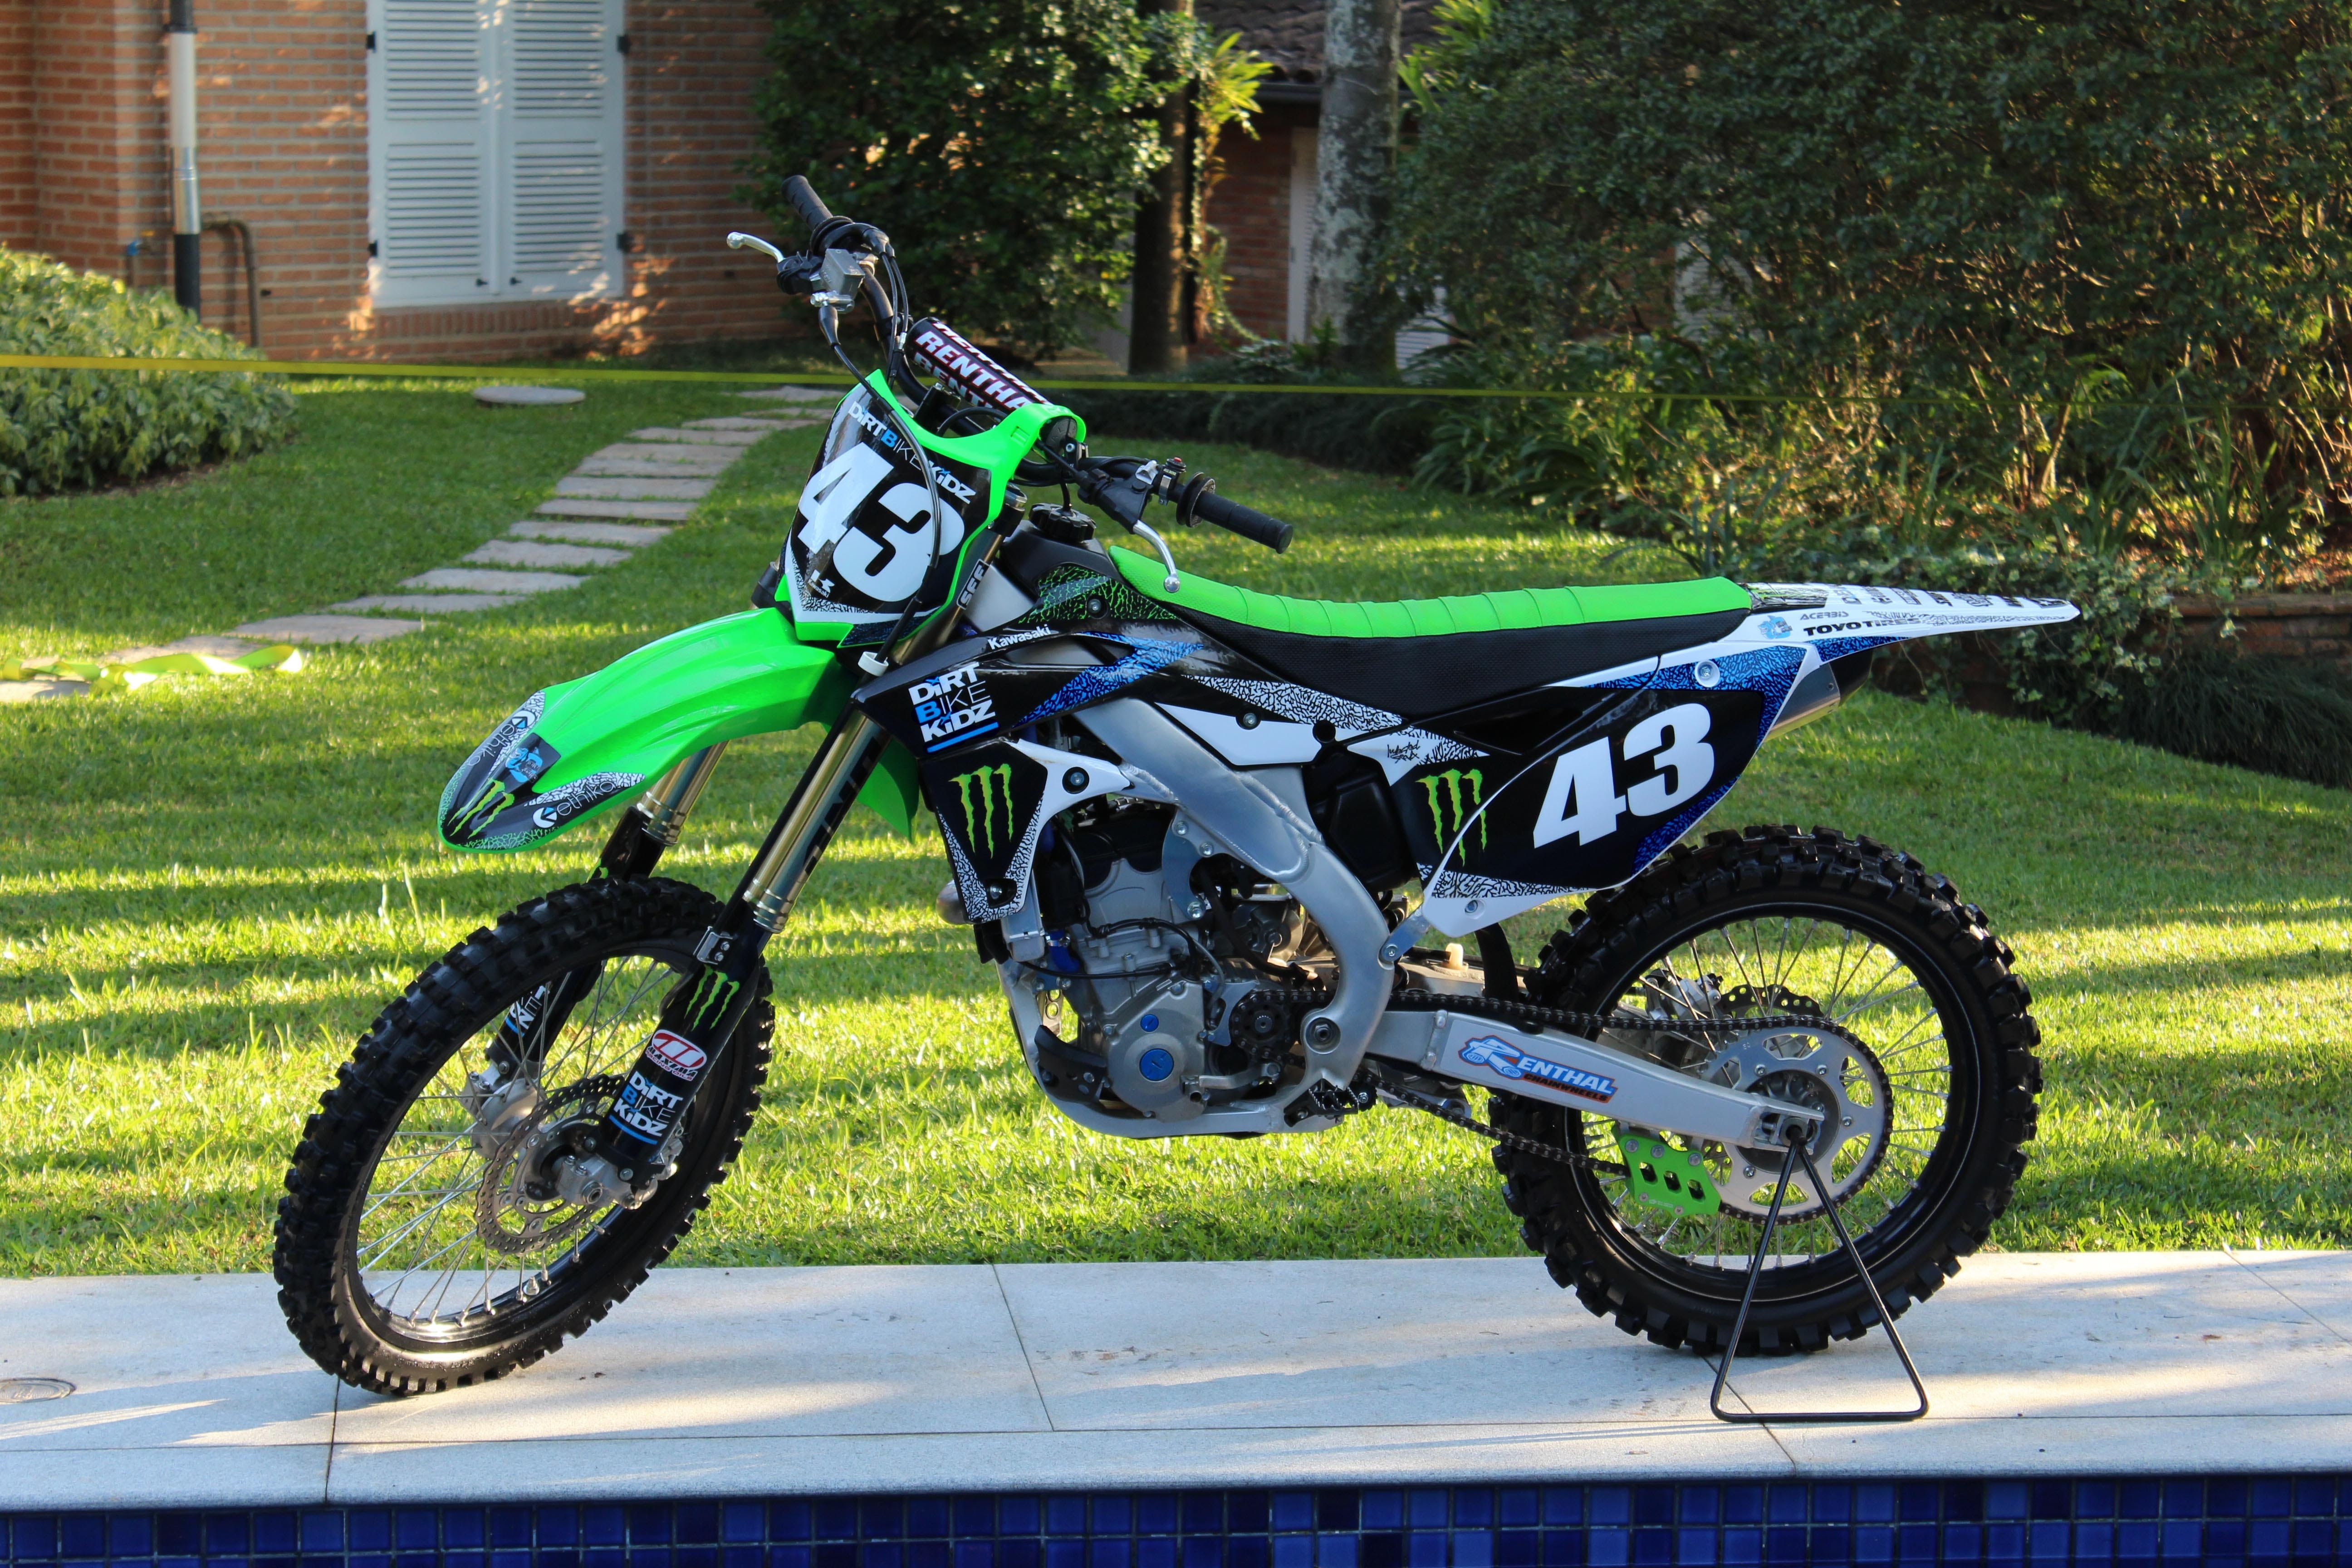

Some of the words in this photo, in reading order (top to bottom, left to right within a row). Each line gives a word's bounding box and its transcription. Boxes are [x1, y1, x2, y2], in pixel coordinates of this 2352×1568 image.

[915, 331, 1035, 411] RENTHA
[797, 442, 965, 602] 43
[988, 624, 1052, 650] Kawasaki
[1803, 621, 1862, 636] TOYO
[915, 681, 990, 724] BIKE
[1533, 702, 1715, 848] 43
[622, 1085, 676, 1123] BIKE
[1524, 1073, 1608, 1102] CHAINWHEELS
